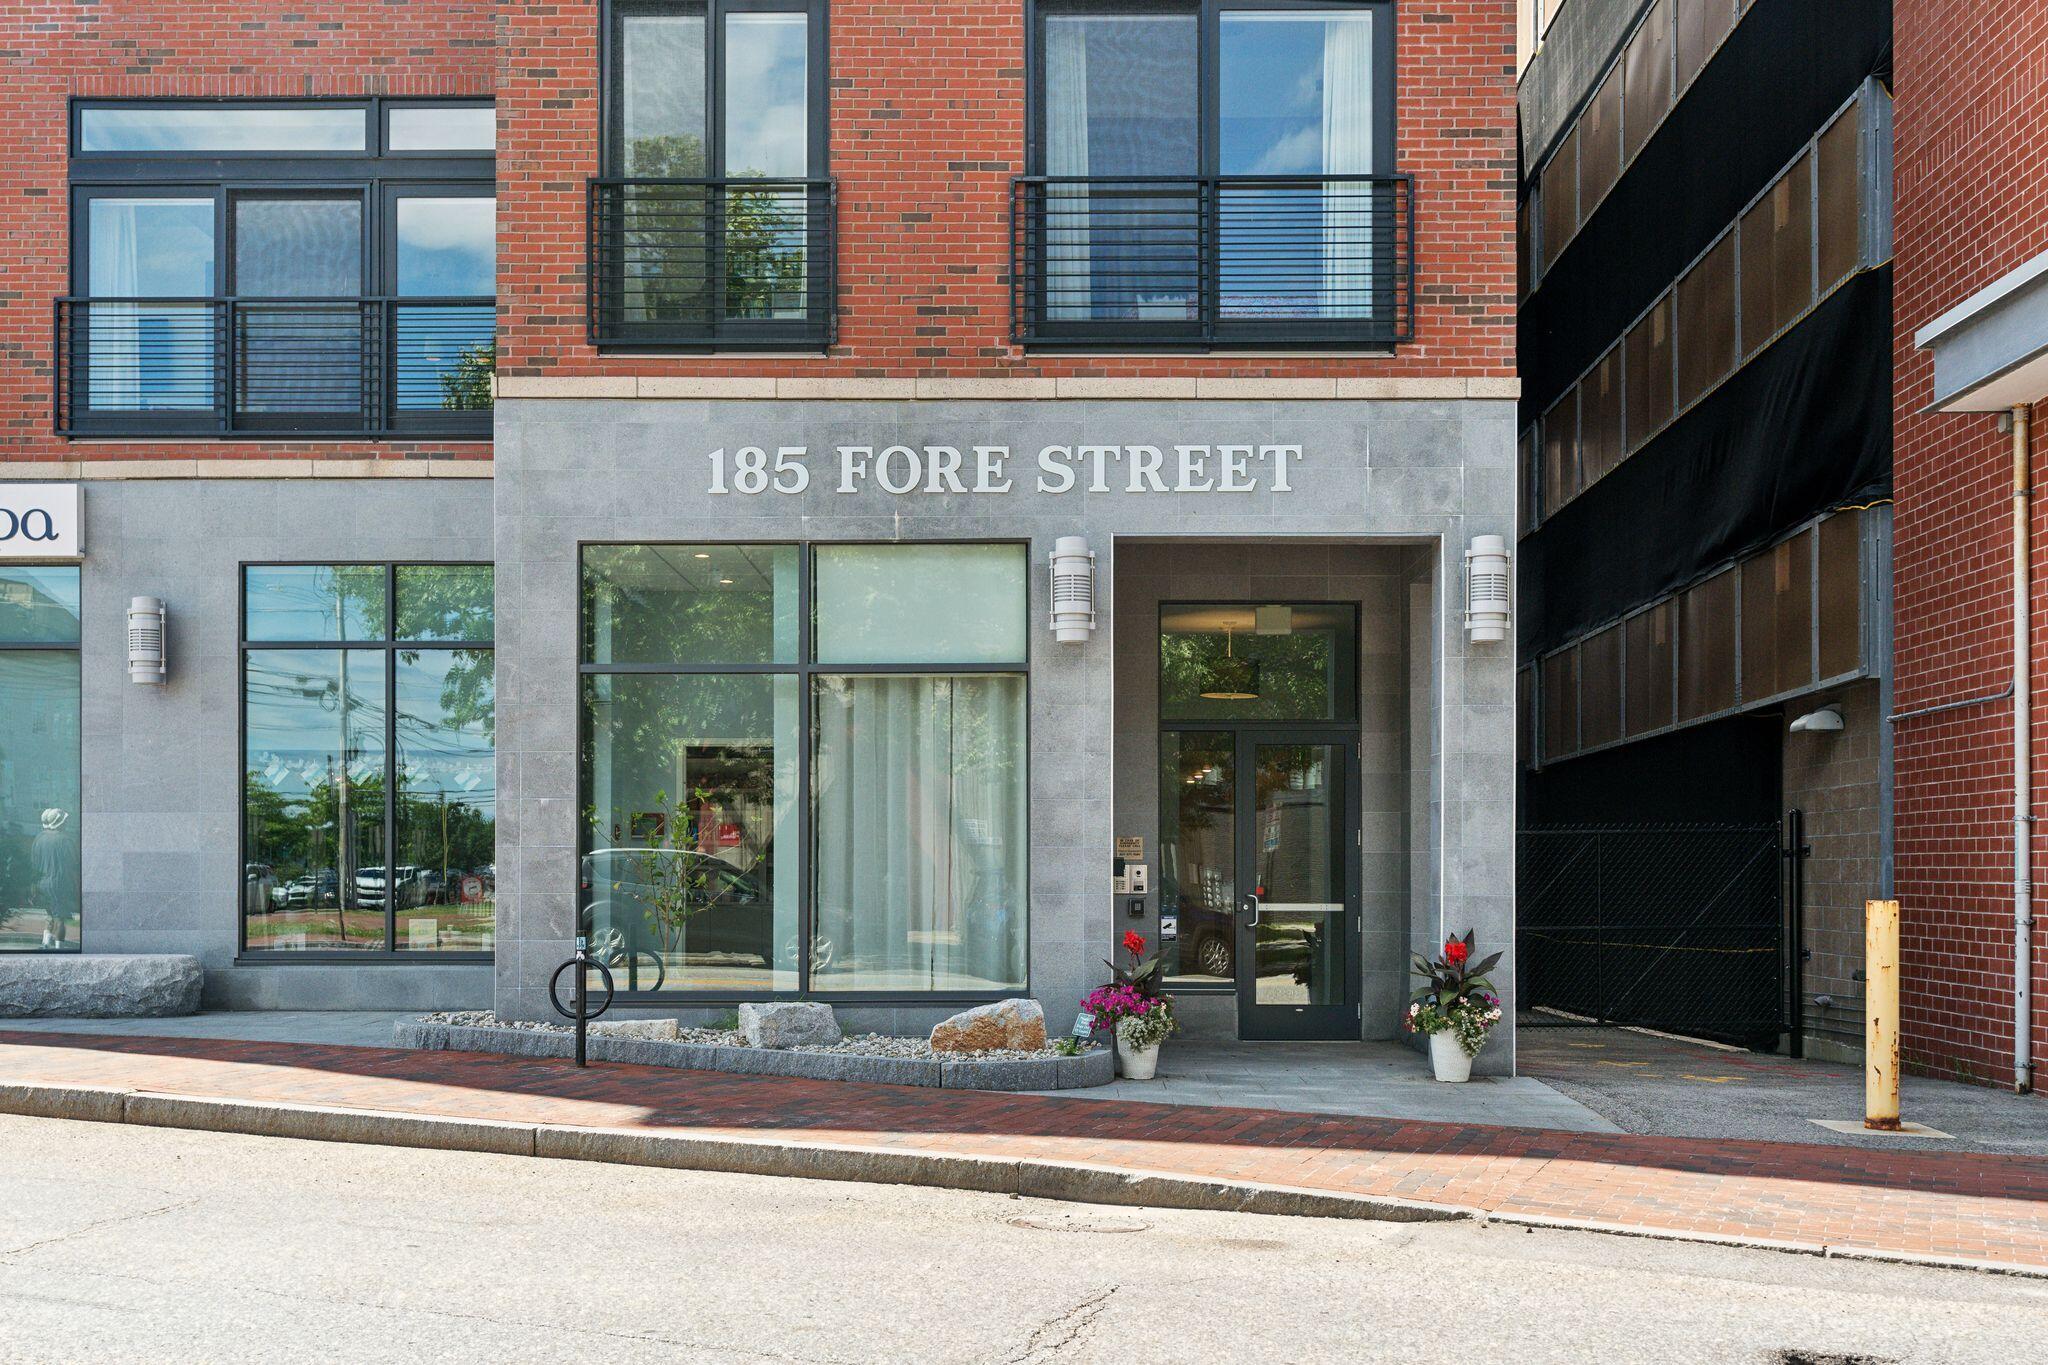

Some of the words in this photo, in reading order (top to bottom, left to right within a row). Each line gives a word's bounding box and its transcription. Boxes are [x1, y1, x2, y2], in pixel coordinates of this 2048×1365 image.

[707, 446, 810, 494] 185
[836, 445, 1013, 494] FORE
[1037, 444, 1303, 493] STREET
